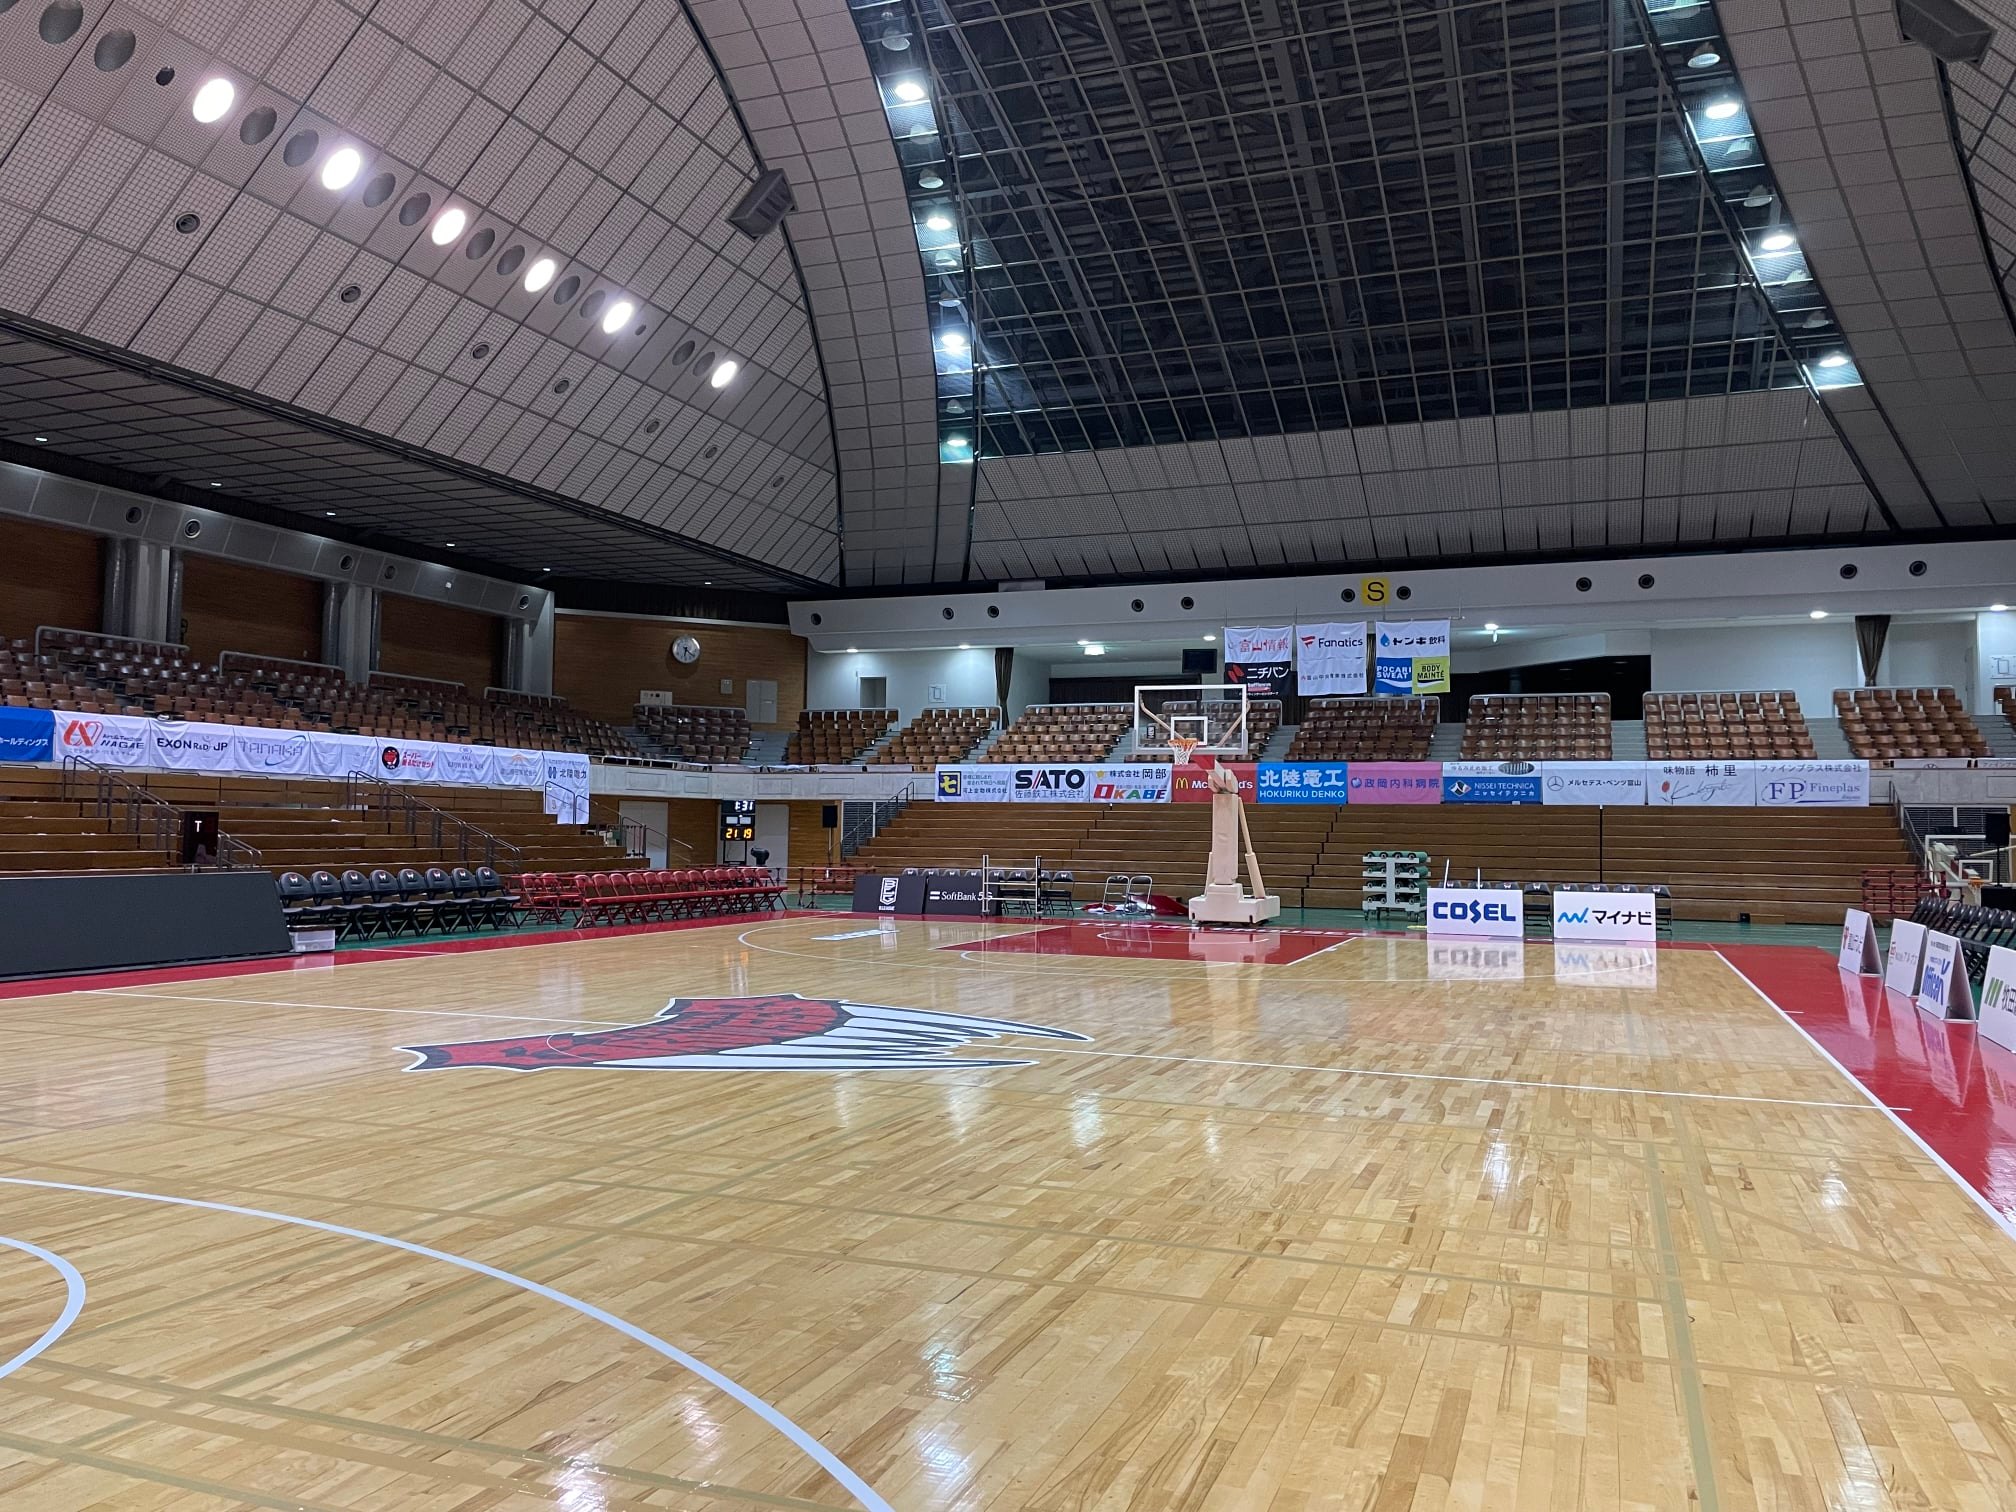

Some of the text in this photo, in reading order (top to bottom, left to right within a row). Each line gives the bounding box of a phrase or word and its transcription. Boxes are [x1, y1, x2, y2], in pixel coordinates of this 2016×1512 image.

[1366, 581, 1386, 602] S
[1318, 636, 1364, 648] Fanatics
[1392, 635, 1446, 646] トンキ飲料
[1246, 666, 1290, 680] ニチバン
[1376, 665, 1412, 673] POCARI
[1421, 664, 1441, 673] BODY
[100, 739, 145, 750] NAGAE
[157, 737, 192, 752] EXON
[213, 741, 229, 752] JP
[238, 739, 303, 757] TANAKA
[1663, 766, 1696, 776] 味物語
[1760, 763, 1863, 773] ファインプラス株式会社
[1015, 768, 1085, 789] SATO
[1259, 768, 1345, 788] 北陸電工
[1093, 783, 1168, 800] OKABE
[1474, 782, 1535, 790] NISSEI TECHNICA
[1768, 781, 1861, 800] FP Fineplas
[1259, 789, 1345, 799] HOKURIKU DENKO
[725, 827, 738, 840] 21
[941, 890, 977, 902] SoftBank
[1432, 899, 1517, 924] COSEL
[1592, 909, 1653, 926] マイナビ
